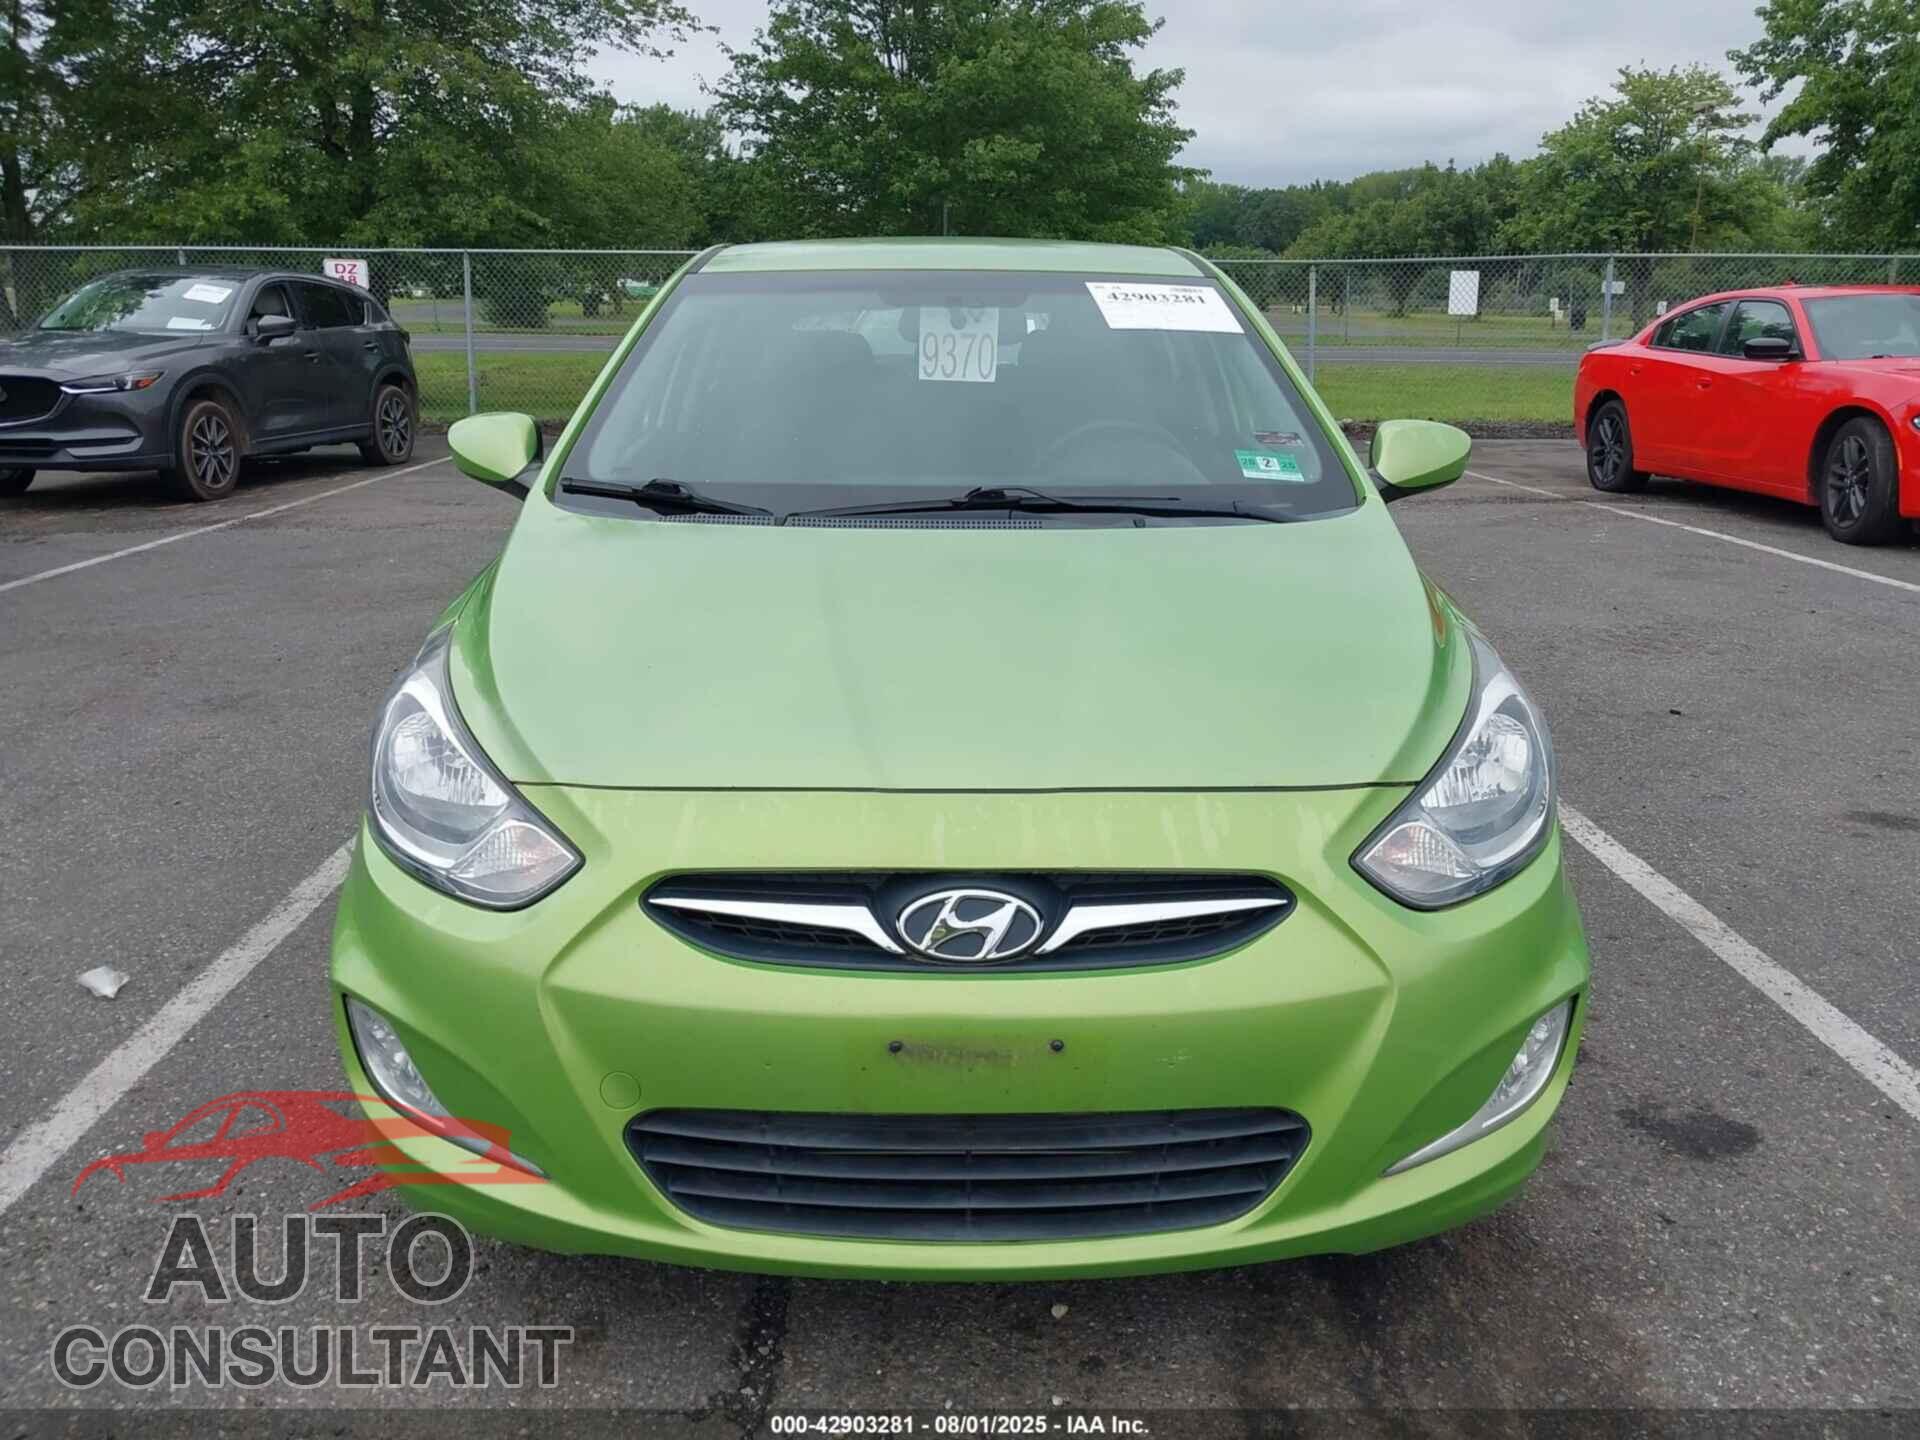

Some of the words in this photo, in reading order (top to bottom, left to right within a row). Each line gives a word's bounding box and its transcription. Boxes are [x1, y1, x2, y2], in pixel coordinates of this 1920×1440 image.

[335, 263, 357, 274] DZ
[1107, 291, 1207, 304] 42903281
[922, 332, 994, 379] 9370
[1263, 458, 1273, 468] 2
